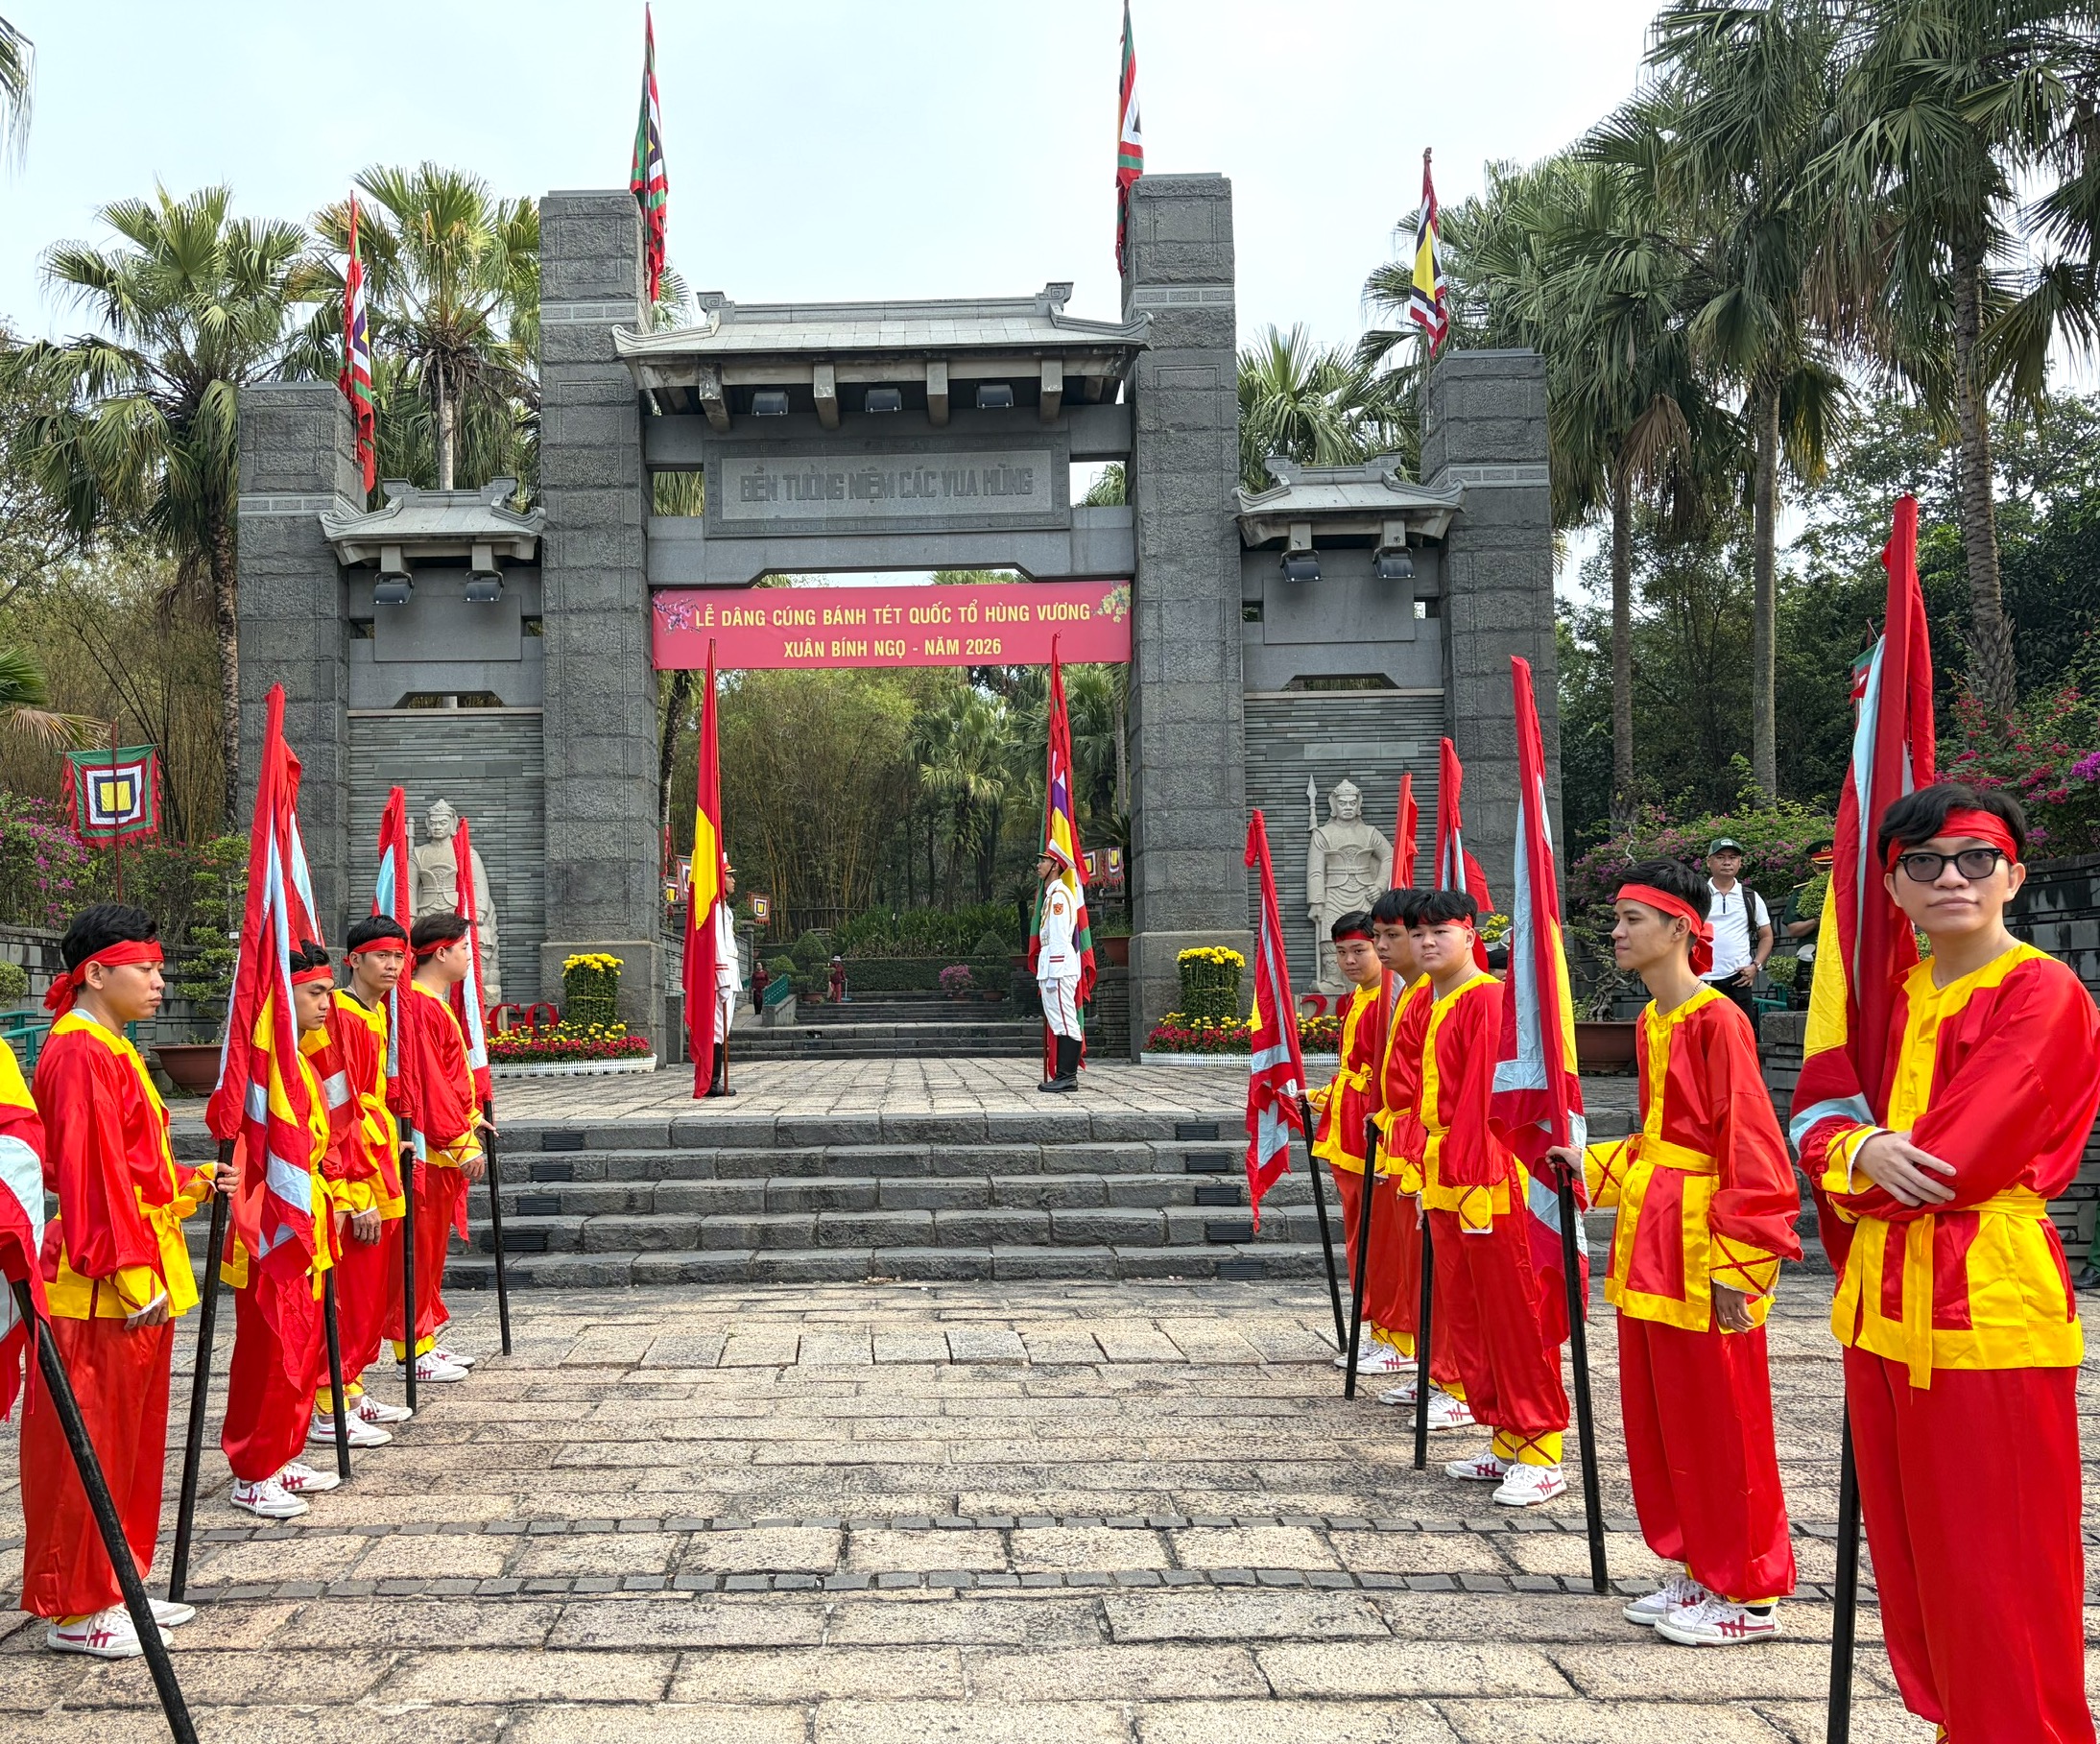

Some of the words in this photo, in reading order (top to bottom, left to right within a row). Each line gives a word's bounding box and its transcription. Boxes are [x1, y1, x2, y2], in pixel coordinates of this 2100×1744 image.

[899, 466, 937, 498] CÁC
[941, 469, 978, 497] VUA
[984, 463, 1033, 495] HÙNG
[695, 603, 715, 628] LỄ
[721, 606, 766, 627] DÂNG
[773, 605, 816, 627] CÚNG
[823, 605, 867, 626] BÁNH
[871, 604, 903, 625] TÉT
[909, 601, 952, 625] QUỐC
[957, 598, 978, 624] TỔ
[985, 601, 1030, 623] HÙNG
[1036, 601, 1090, 621] VƯƠNG
[783, 637, 825, 658] XUÂN
[831, 636, 868, 657] BÍNH
[873, 639, 906, 659] NGỌ
[924, 635, 960, 657] NĂM
[966, 637, 1002, 656] 2026
